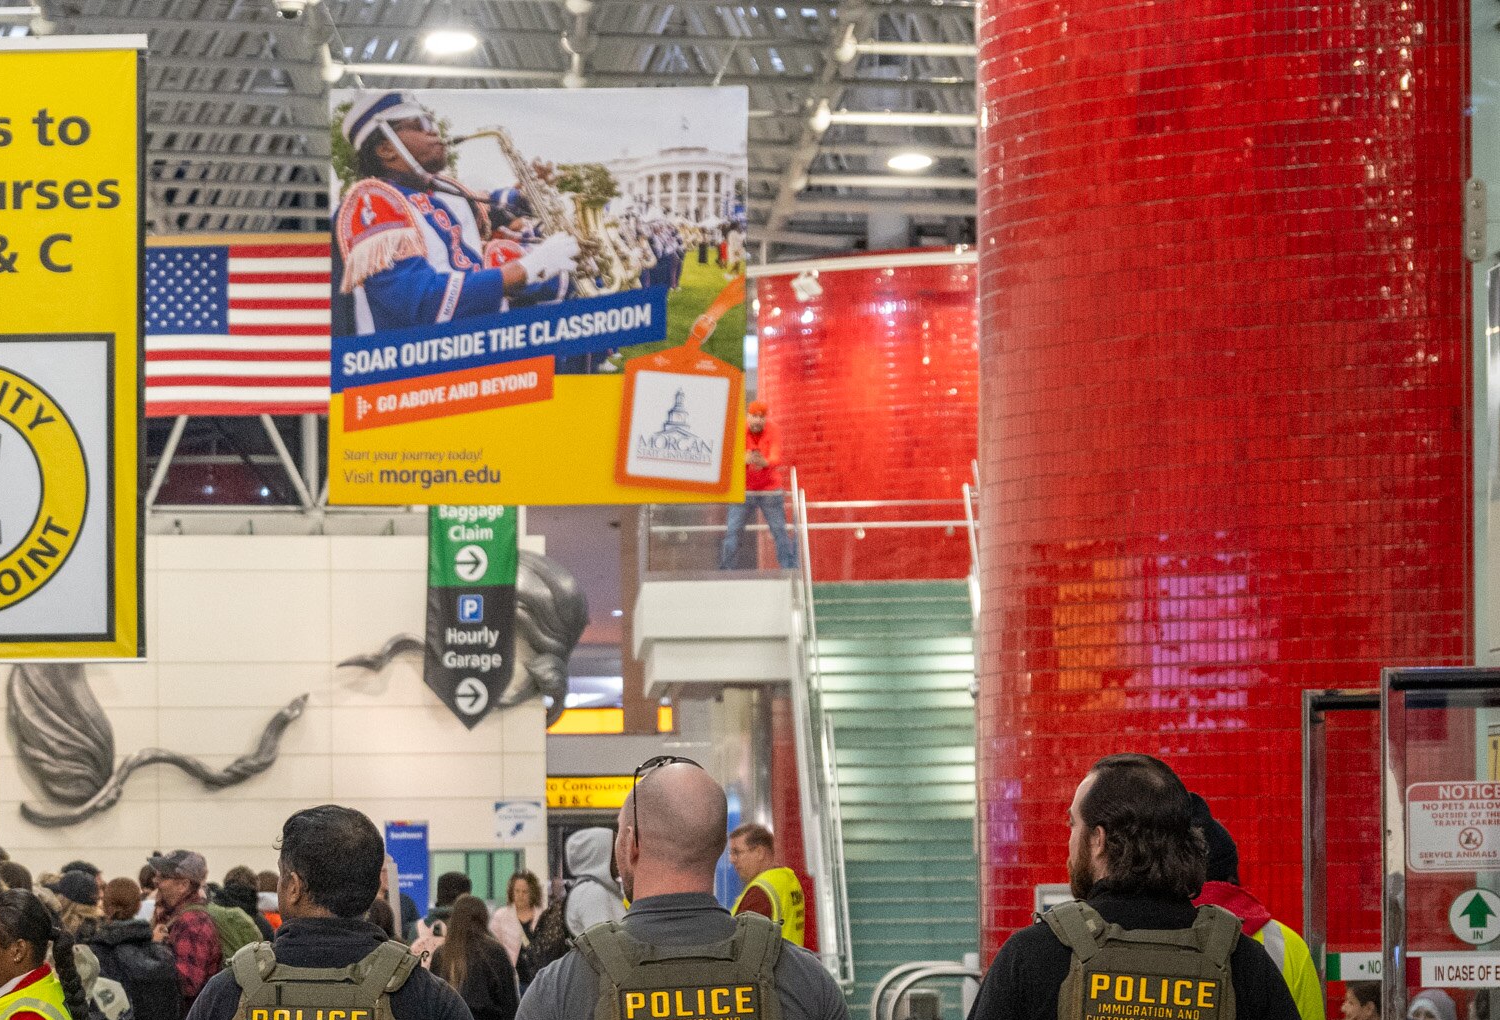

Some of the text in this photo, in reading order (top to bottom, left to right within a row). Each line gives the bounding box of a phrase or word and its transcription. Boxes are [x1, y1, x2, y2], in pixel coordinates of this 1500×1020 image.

[32, 109, 91, 146] to
[39, 233, 73, 273] C
[343, 303, 652, 376] SOAR OUTSIDE THE CLASSROOM
[376, 371, 538, 413] GO ABOVE AND BEYOND
[637, 434, 713, 455] MORGAN
[344, 448, 482, 463] Start your journey today!
[663, 450, 711, 463] UNIVERSITY
[343, 465, 501, 489] Visit morgan.edu
[438, 505, 505, 522] Baggage
[448, 525, 494, 542] Claim
[464, 600, 478, 617] P
[445, 627, 500, 648] Hourly
[442, 652, 503, 672] Garage
[1438, 785, 1500, 799] NOTICE
[1422, 803, 1439, 811] NO
[1442, 803, 1465, 811] PETS
[1431, 811, 1467, 819] OUTSIDE
[1419, 851, 1498, 859] SERVICE ANIMALS
[1473, 930, 1483, 940] IN
[1434, 965, 1445, 981] IN
[1447, 965, 1475, 981] CASE
[1478, 965, 1492, 981] OF
[1090, 973, 1216, 1009] POLICE
[626, 986, 755, 1019] POLICE
[1097, 1003, 1200, 1020] IMMIGRATION AND
